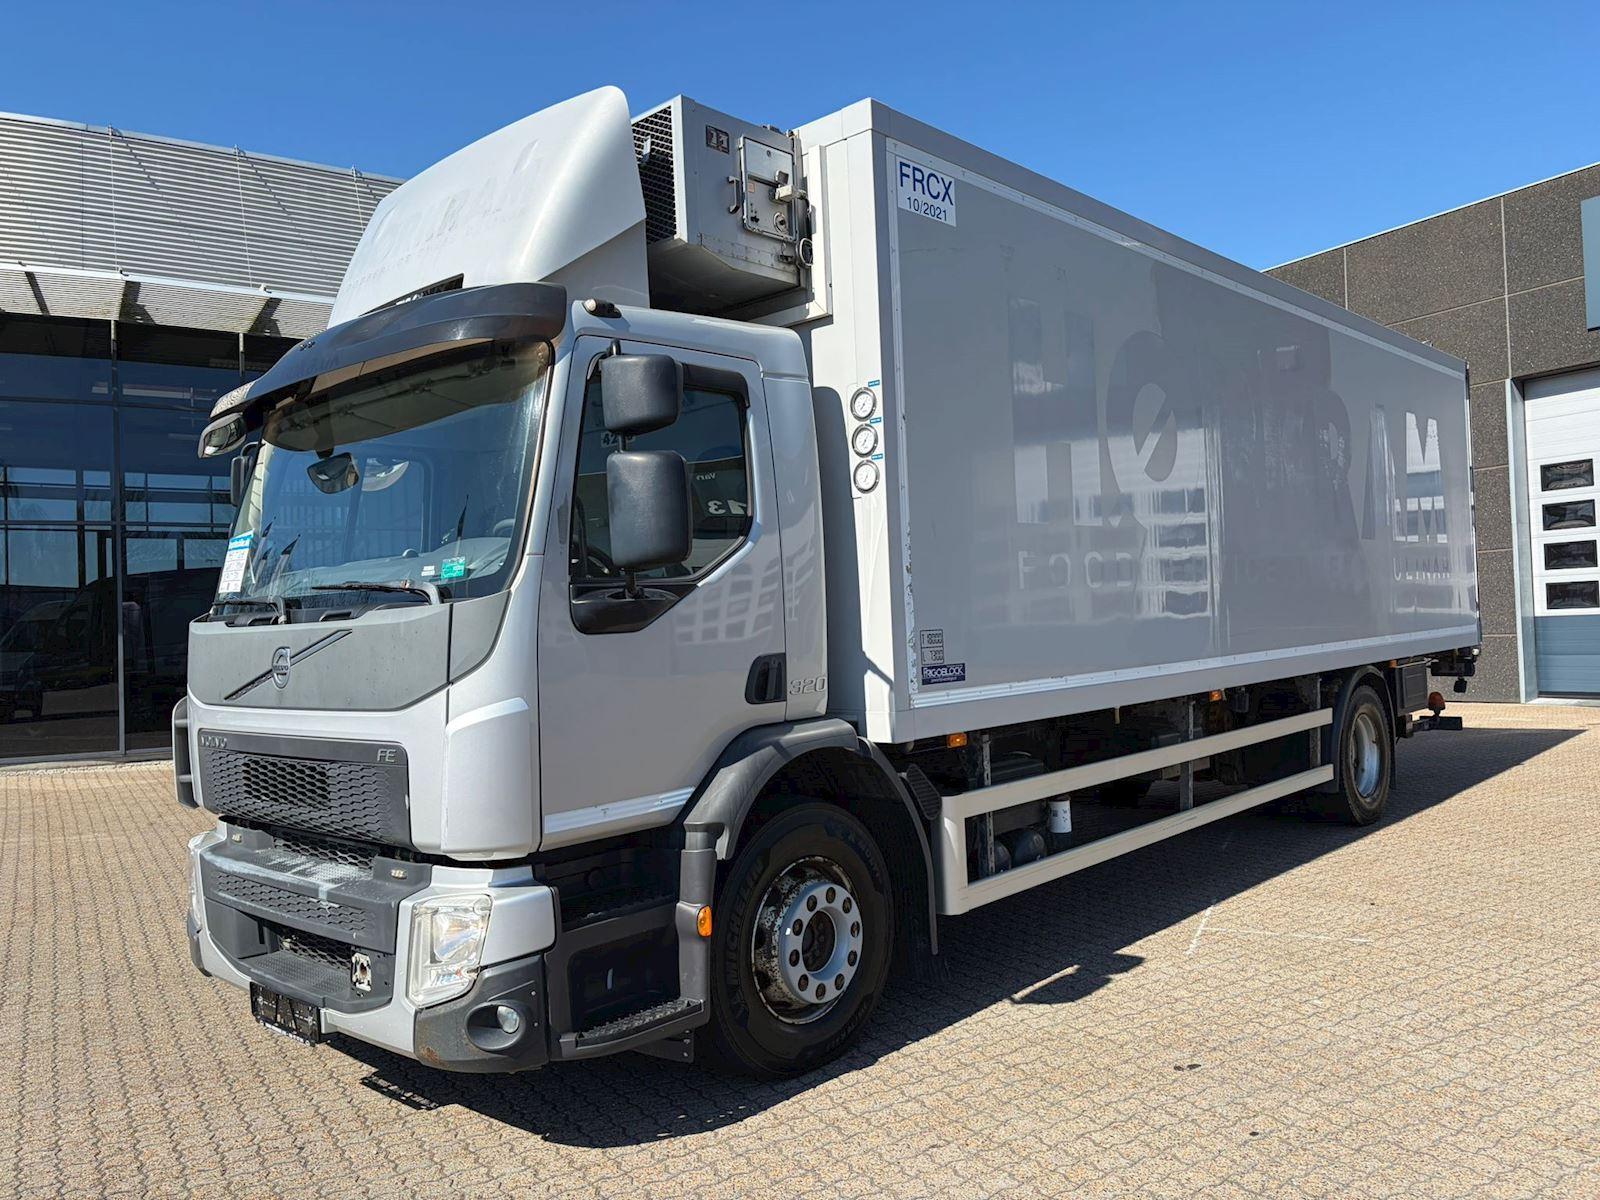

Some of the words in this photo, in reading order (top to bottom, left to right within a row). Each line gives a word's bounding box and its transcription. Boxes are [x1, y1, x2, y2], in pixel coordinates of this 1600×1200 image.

[899, 161, 954, 206] FRCX
[906, 196, 948, 222] 10/2021
[789, 676, 827, 695] 320
[376, 749, 396, 762] FE
